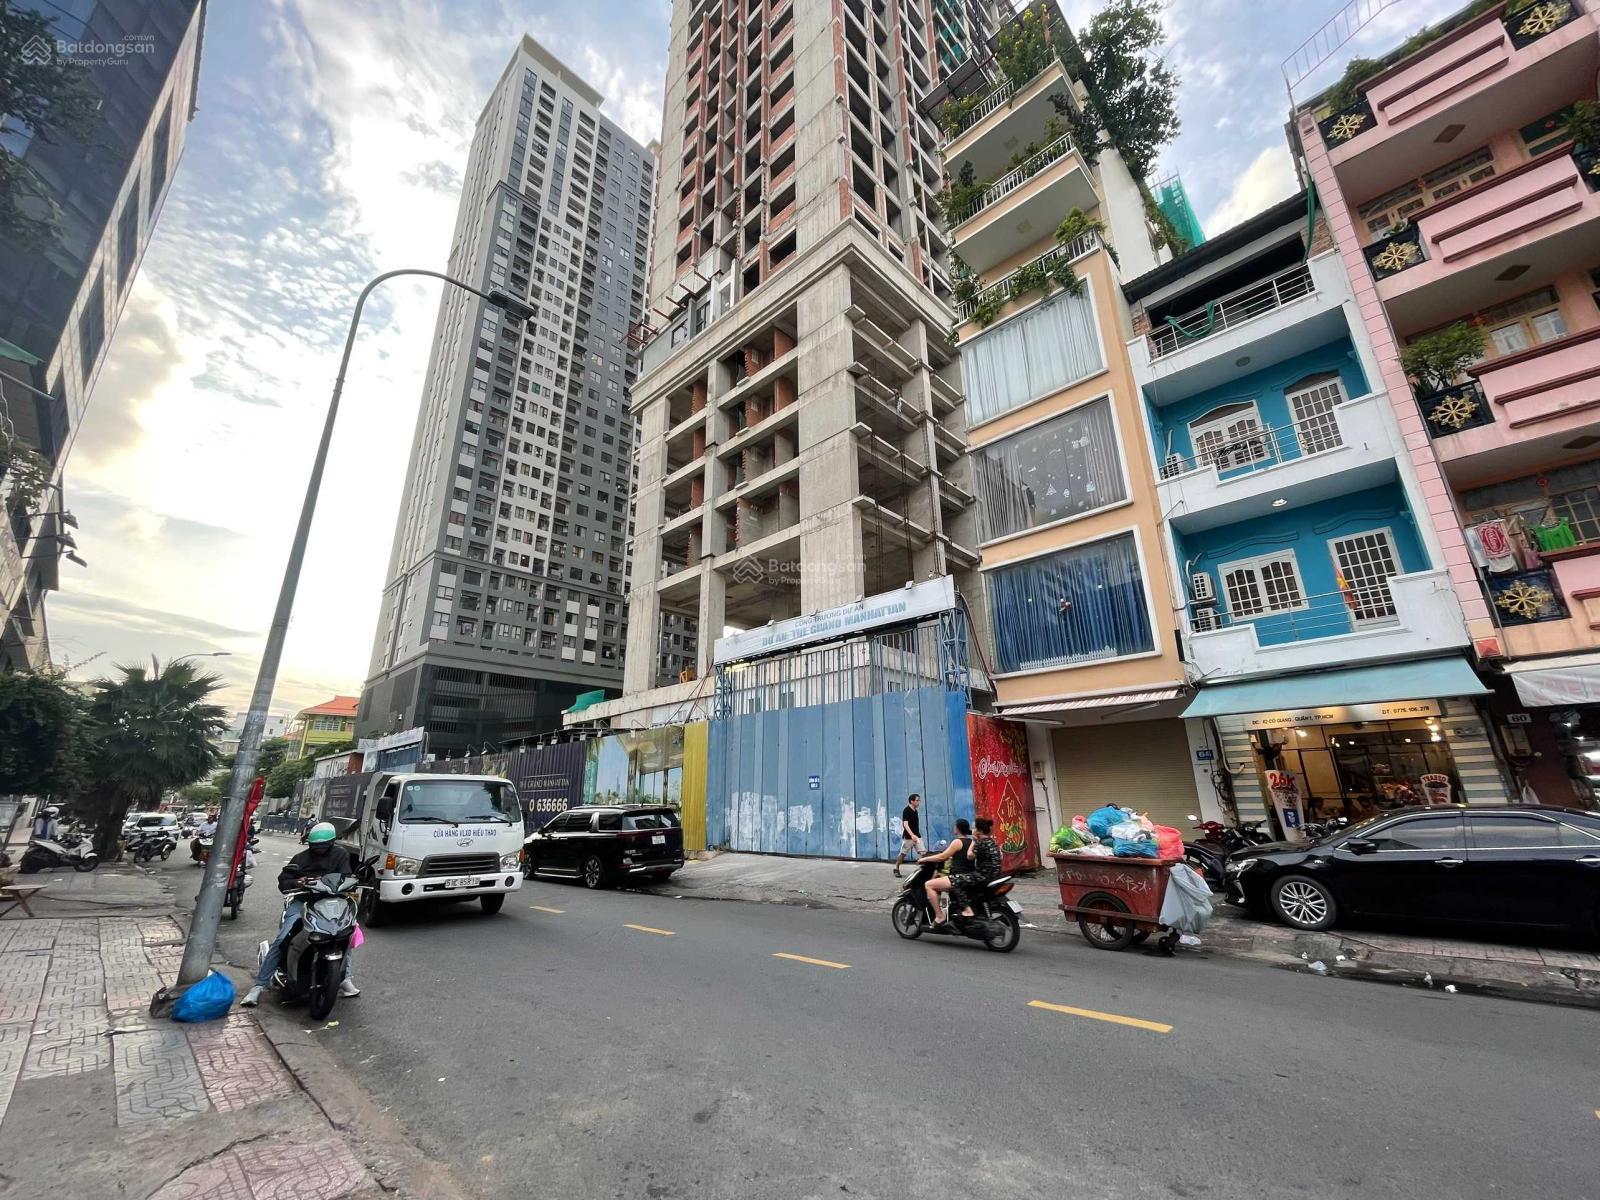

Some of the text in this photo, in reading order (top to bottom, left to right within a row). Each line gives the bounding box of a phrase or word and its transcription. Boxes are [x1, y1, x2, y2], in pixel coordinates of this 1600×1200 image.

[845, 601, 906, 626] MANHATTAN
[1512, 714, 1527, 722] 60
[536, 797, 568, 812] 636666
